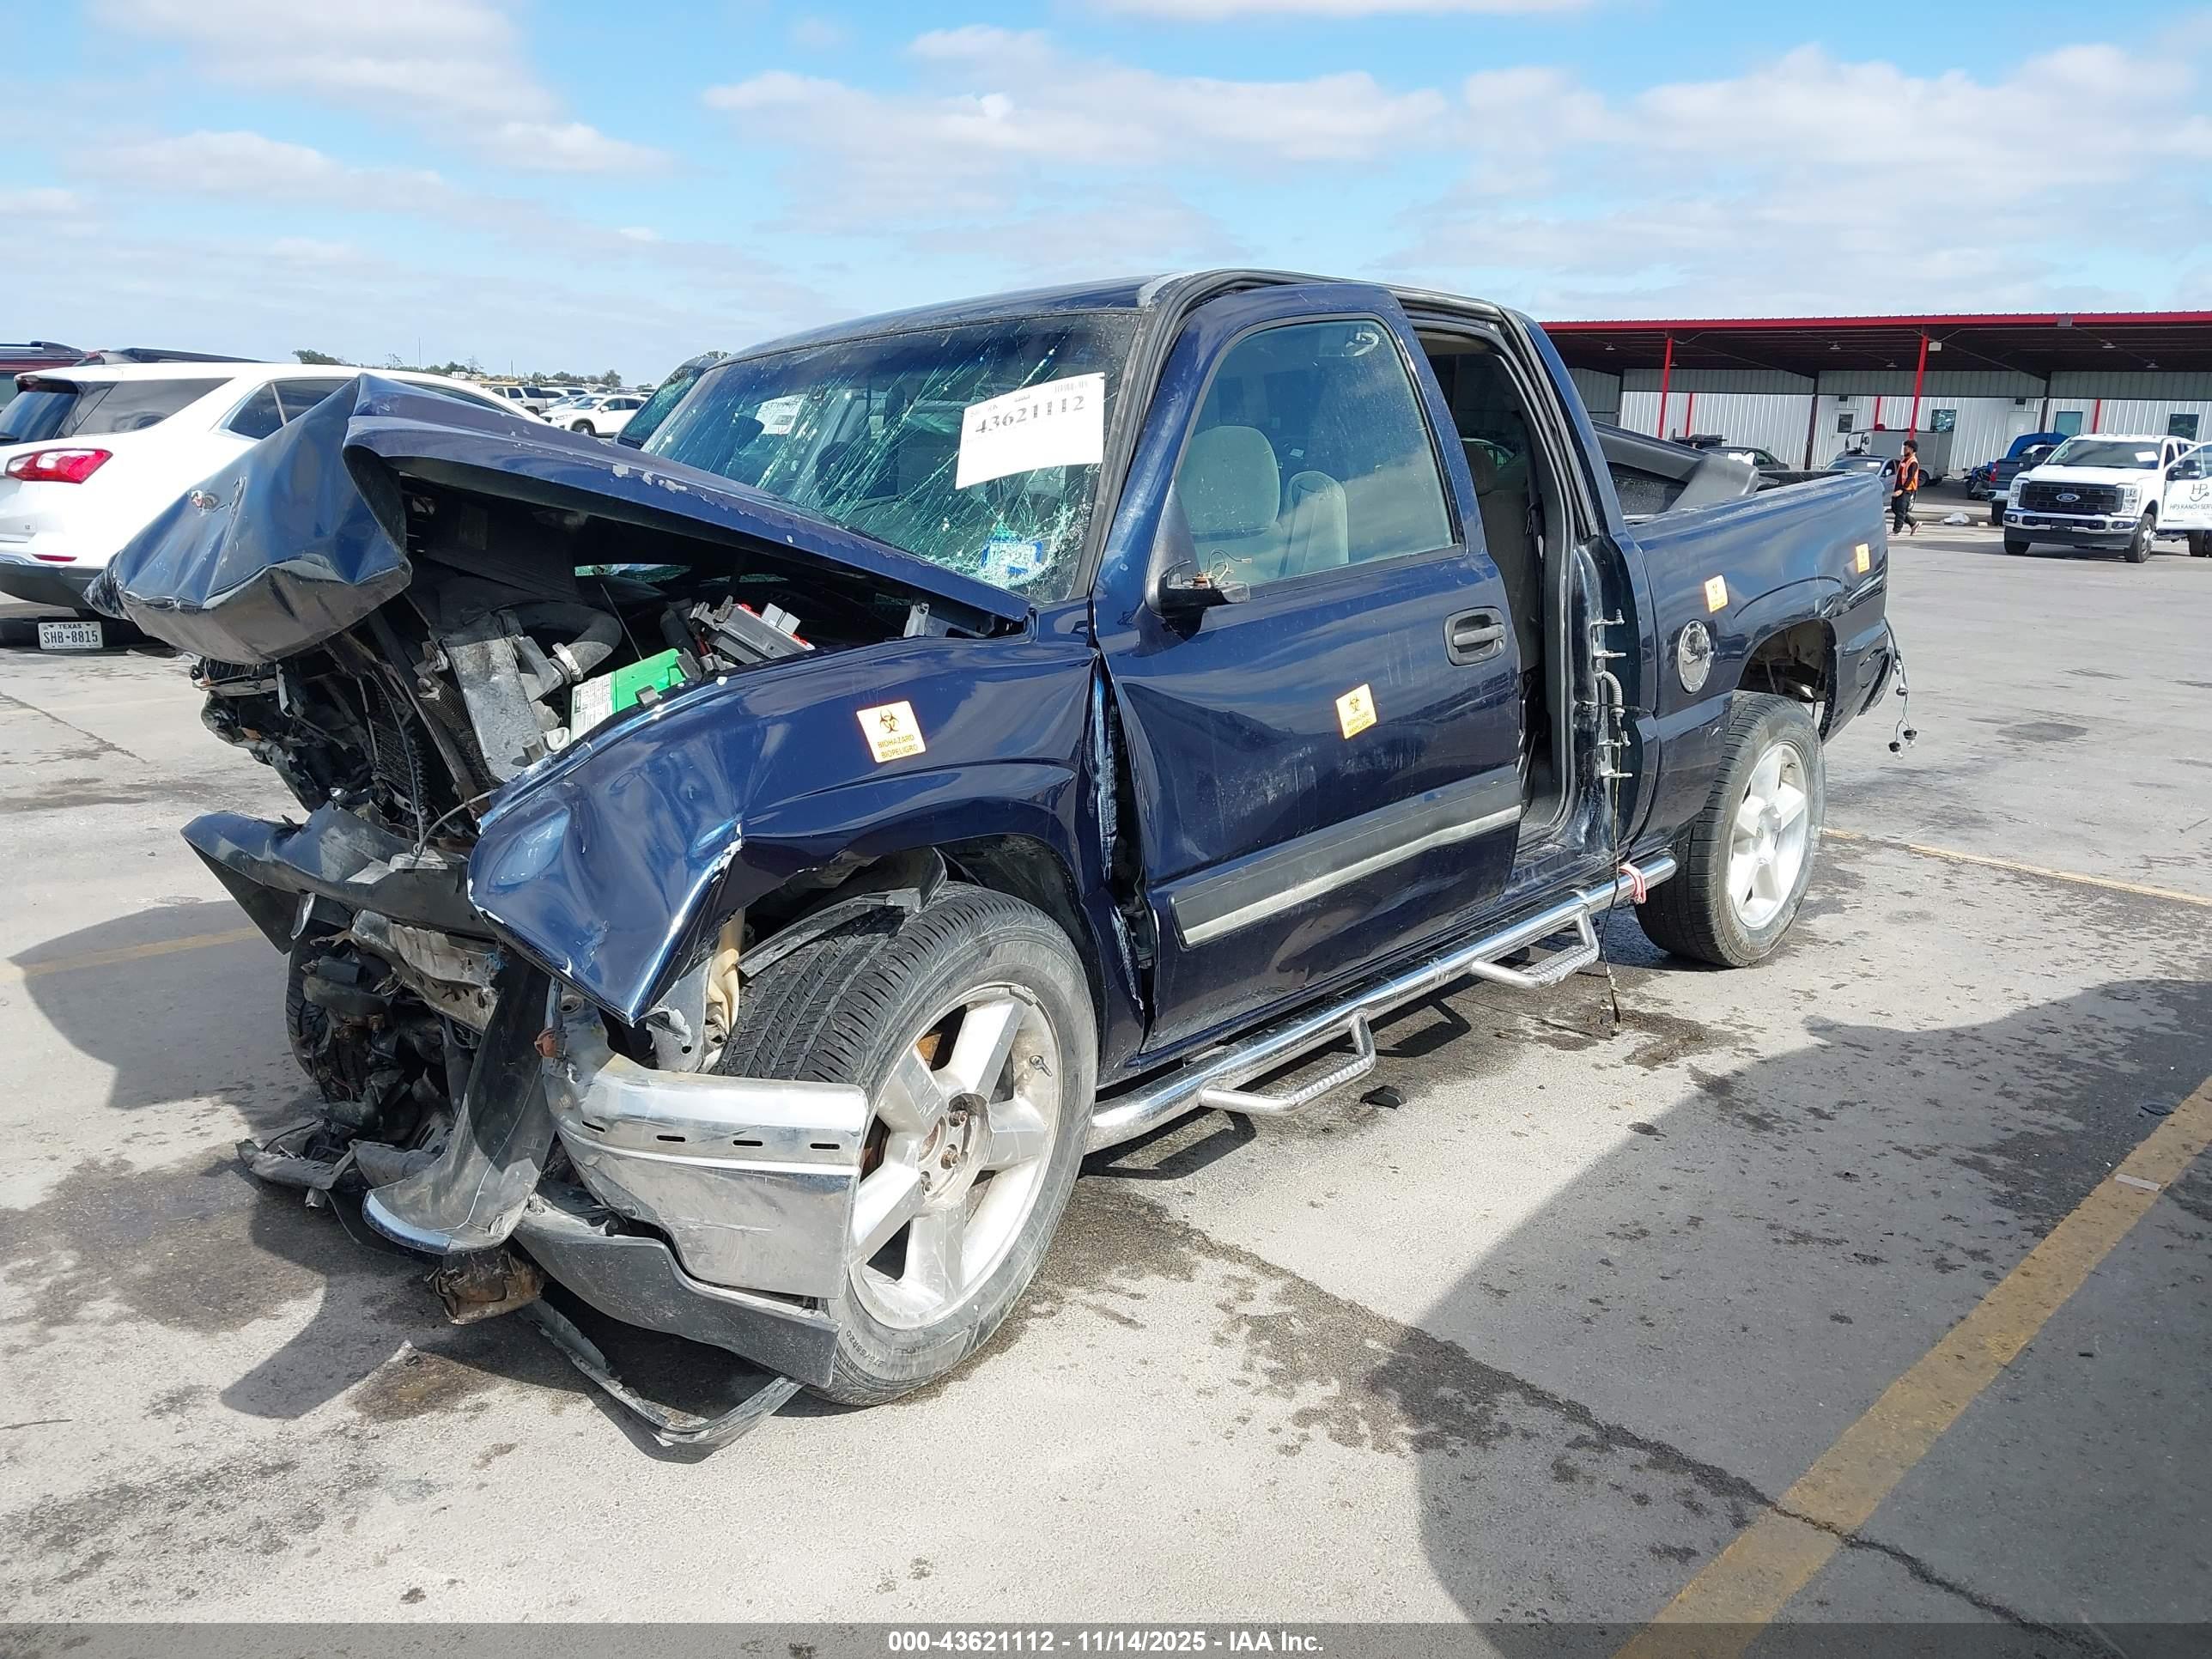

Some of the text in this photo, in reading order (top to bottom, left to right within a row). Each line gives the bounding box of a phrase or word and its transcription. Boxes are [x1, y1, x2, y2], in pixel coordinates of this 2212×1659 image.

[975, 395, 1085, 433] 43621112
[877, 734, 915, 749] BIOHAZARD
[881, 744, 918, 759] BIOPELIGRO
